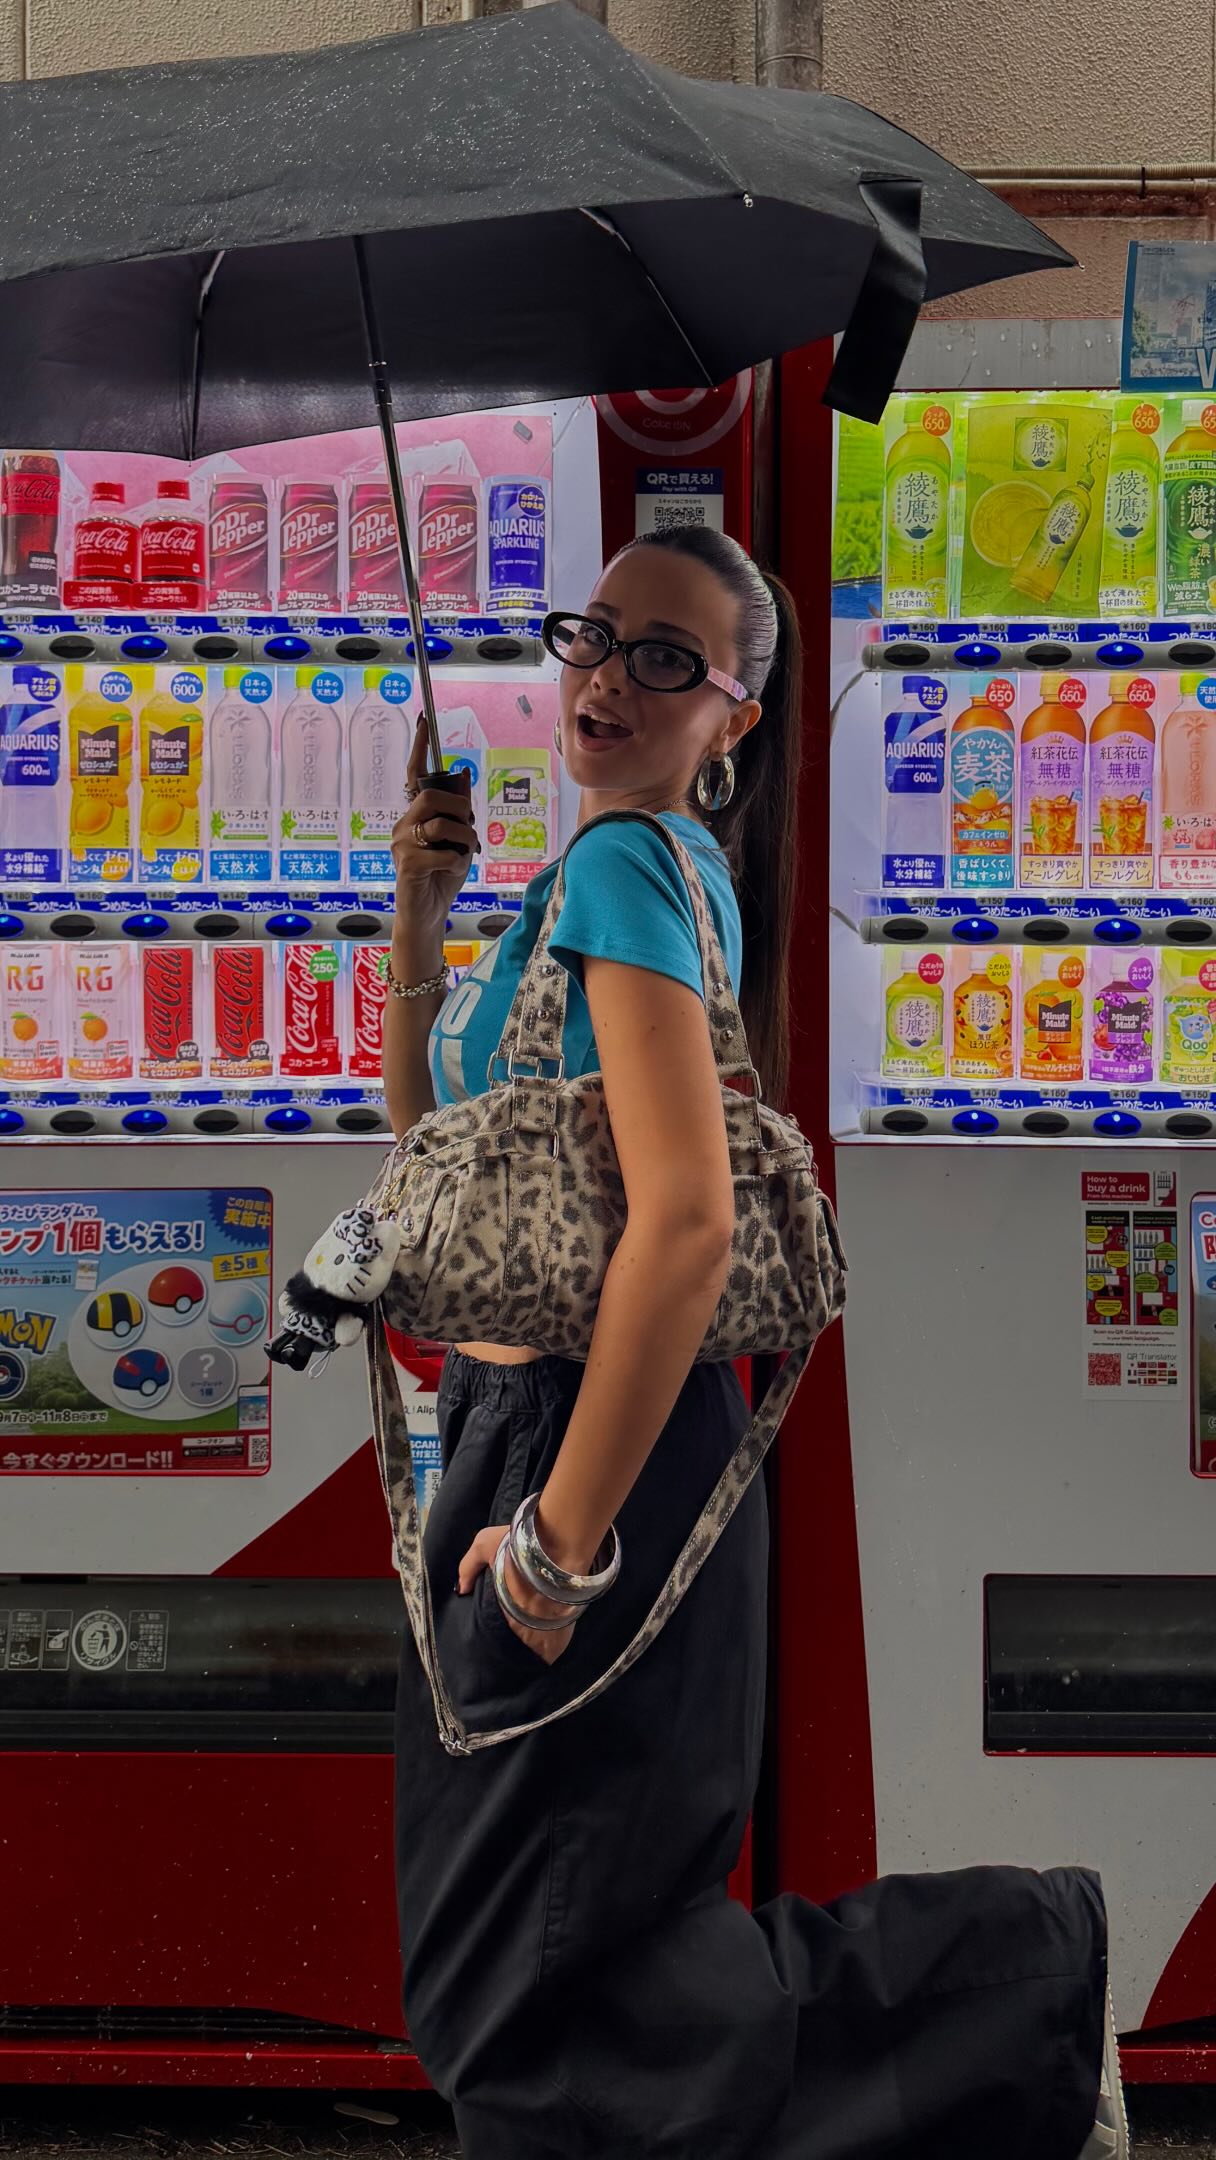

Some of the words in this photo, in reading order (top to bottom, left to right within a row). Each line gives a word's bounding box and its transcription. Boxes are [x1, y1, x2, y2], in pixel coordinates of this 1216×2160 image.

[1031, 423, 1051, 458] 綾鷹
[646, 473, 714, 486] QRで買える!
[904, 471, 931, 525] 綾鷹
[1114, 469, 1141, 523] 綾鷹
[1187, 484, 1210, 527] 綾鷹
[226, 511, 249, 530] Dr
[297, 512, 320, 530] Dr
[365, 512, 389, 531] Dr
[436, 512, 459, 531] Dr
[488, 518, 545, 538] AQUARIUS
[211, 519, 265, 551] Pepper
[282, 520, 336, 552] Pepper
[351, 521, 397, 553] Peppe
[421, 521, 474, 553] Pepper
[492, 537, 540, 550] SPARKLING
[1122, 622, 1147, 631] ¥160
[244, 678, 268, 687] 日本の
[316, 679, 338, 688] 日本の
[384, 679, 407, 688] 日本の
[244, 688, 269, 697] 天然水
[316, 688, 340, 698] 天然水
[384, 689, 408, 698] 天然水
[0, 733, 59, 751] AQUARIUS
[80, 738, 116, 749] Minute
[151, 739, 187, 749] Minute
[84, 749, 111, 758] Maid
[155, 749, 182, 759] Maid
[885, 742, 945, 759] AQUARIUS
[1030, 746, 1079, 760] 紅茶花伝
[1099, 746, 1148, 760] 紅茶花伝
[22, 764, 50, 776] 600ml
[953, 749, 1013, 783] 麦茶
[1038, 762, 1072, 779] 無糖
[1106, 762, 1142, 779] 無糖
[913, 771, 937, 783] 600ml
[218, 861, 260, 875] 天然水
[288, 861, 329, 875] 天然水
[358, 862, 396, 875] 天然水
[892, 857, 937, 869] 水より優れた
[958, 857, 1010, 869] 香ばしくて、
[1027, 860, 1078, 869] すっきり爽やか
[1097, 860, 1149, 869] すっきり爽やか
[895, 868, 933, 880] 水分補給
[956, 869, 1012, 882] 後味すっきり
[1023, 869, 1081, 882] アールグレイ
[1093, 869, 1151, 882] アールグレイ
[7, 965, 44, 993] RG
[77, 965, 113, 993] RG
[975, 993, 992, 1024] 綾鷹
[905, 1000, 925, 1036] 綾鷹
[1041, 1011, 1070, 1021] Minute
[1111, 1013, 1140, 1022] Minute
[1045, 1019, 1068, 1028] Maid
[1115, 1021, 1138, 1029] Maid
[969, 1040, 1000, 1050] ほうじ茶
[1181, 1039, 1209, 1051] Qoo
[288, 1058, 329, 1068] コカ・コーラ
[1086, 1175, 1107, 1183] How
[1108, 1175, 1118, 1183] to
[1086, 1184, 1107, 1193] buy
[1118, 1184, 1146, 1193] drink
[0, 1221, 203, 1254] ンプ1個もらえる!
[1140, 1352, 1178, 1361] Translator
[199, 1353, 216, 1378] ?
[416, 1405, 436, 1415] Alip
[3, 1451, 173, 1469] 今すぐダウンロード!!
